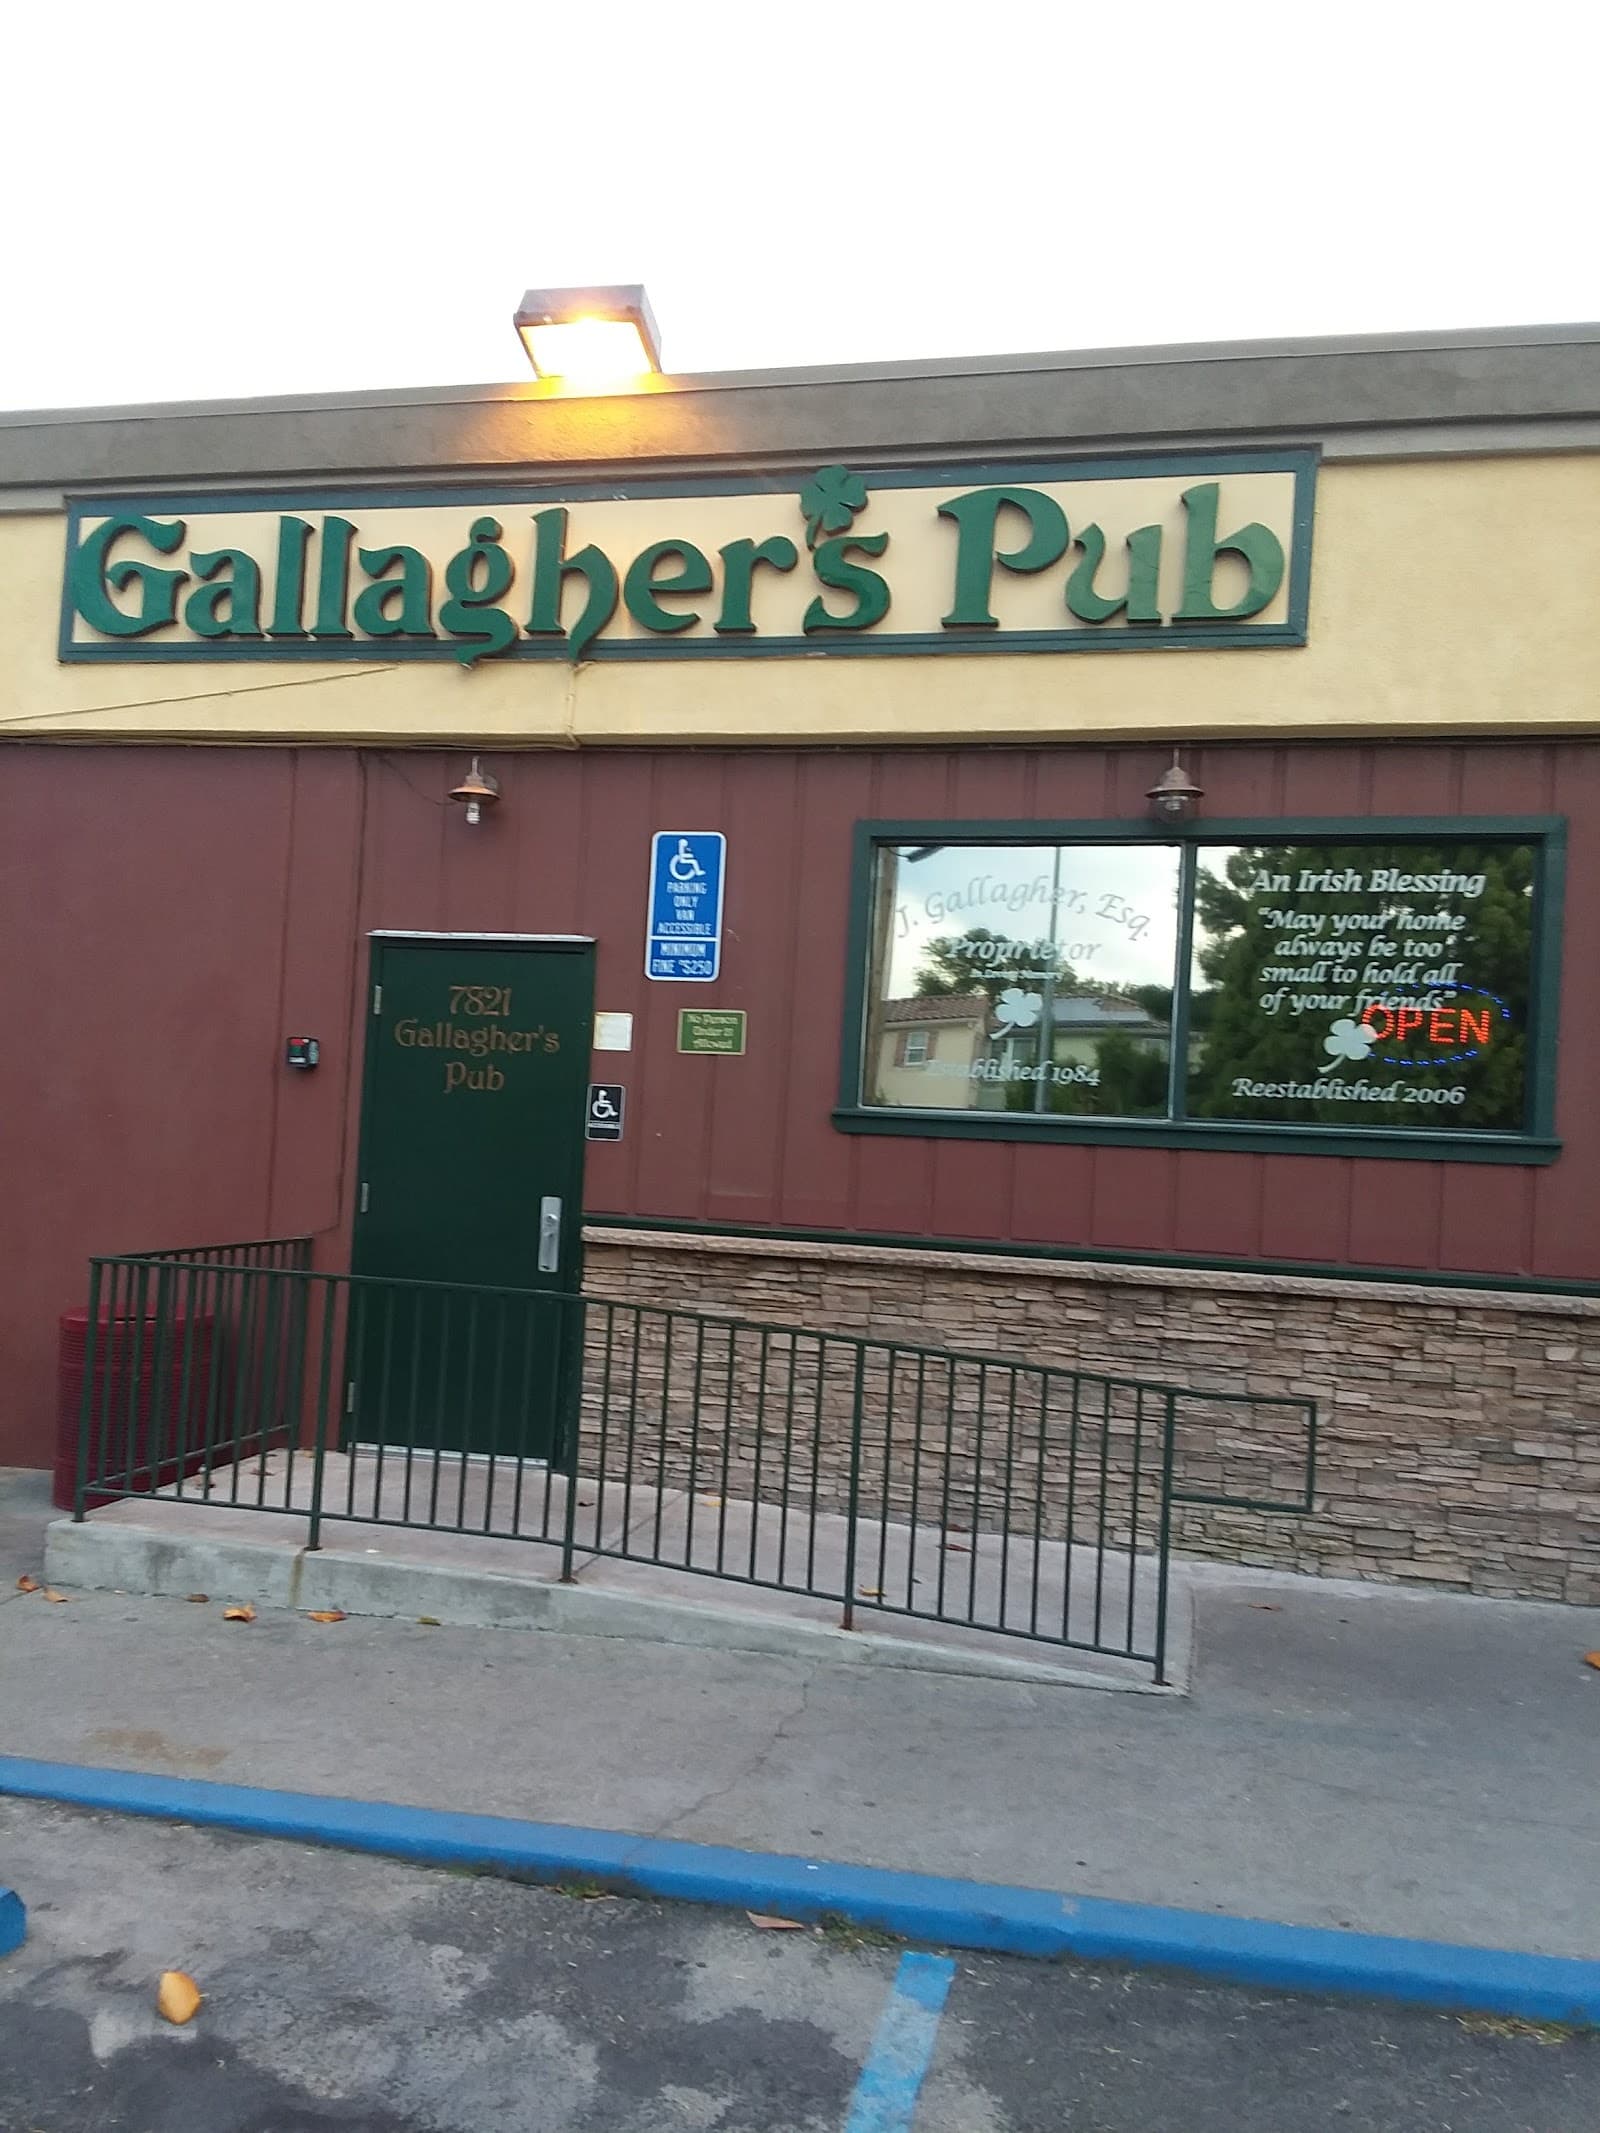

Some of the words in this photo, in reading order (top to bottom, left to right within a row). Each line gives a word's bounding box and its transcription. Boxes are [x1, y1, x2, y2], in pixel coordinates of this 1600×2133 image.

[937, 482, 1286, 626] Pub
[666, 881, 708, 895] PARKING
[1253, 868, 1290, 892] An
[1295, 868, 1362, 893] Irish
[1367, 867, 1487, 898] Blessing
[673, 895, 699, 908] ONLY
[675, 909, 696, 921] VAN
[925, 874, 1088, 924] Gallagher,
[1095, 893, 1153, 942] Esq.
[657, 922, 712, 935] ACCESSIBLE
[1330, 913, 1388, 937] your
[1396, 910, 1466, 932] home
[659, 942, 707, 957] MINIMUM
[944, 936, 1102, 967] Proprietor
[1274, 934, 1363, 963] always
[1367, 934, 1398, 958] be
[1403, 938, 1444, 958] too
[652, 959, 675, 973] FINE
[678, 959, 713, 975] $250
[1258, 960, 1332, 984] small
[1331, 964, 1357, 984] to
[1361, 962, 1421, 984] hold
[1421, 963, 1464, 985] all
[449, 985, 513, 1016] 7821
[1258, 987, 1289, 1016] of
[1289, 992, 1351, 1016] your
[394, 1018, 561, 1057] Gallagher's
[1361, 1003, 1491, 1045] OPEN
[443, 1061, 505, 1094] Pub
[1051, 1064, 1101, 1086] 1984
[1231, 1077, 1405, 1103] Reestablished
[1402, 1085, 1467, 1105] 2006
